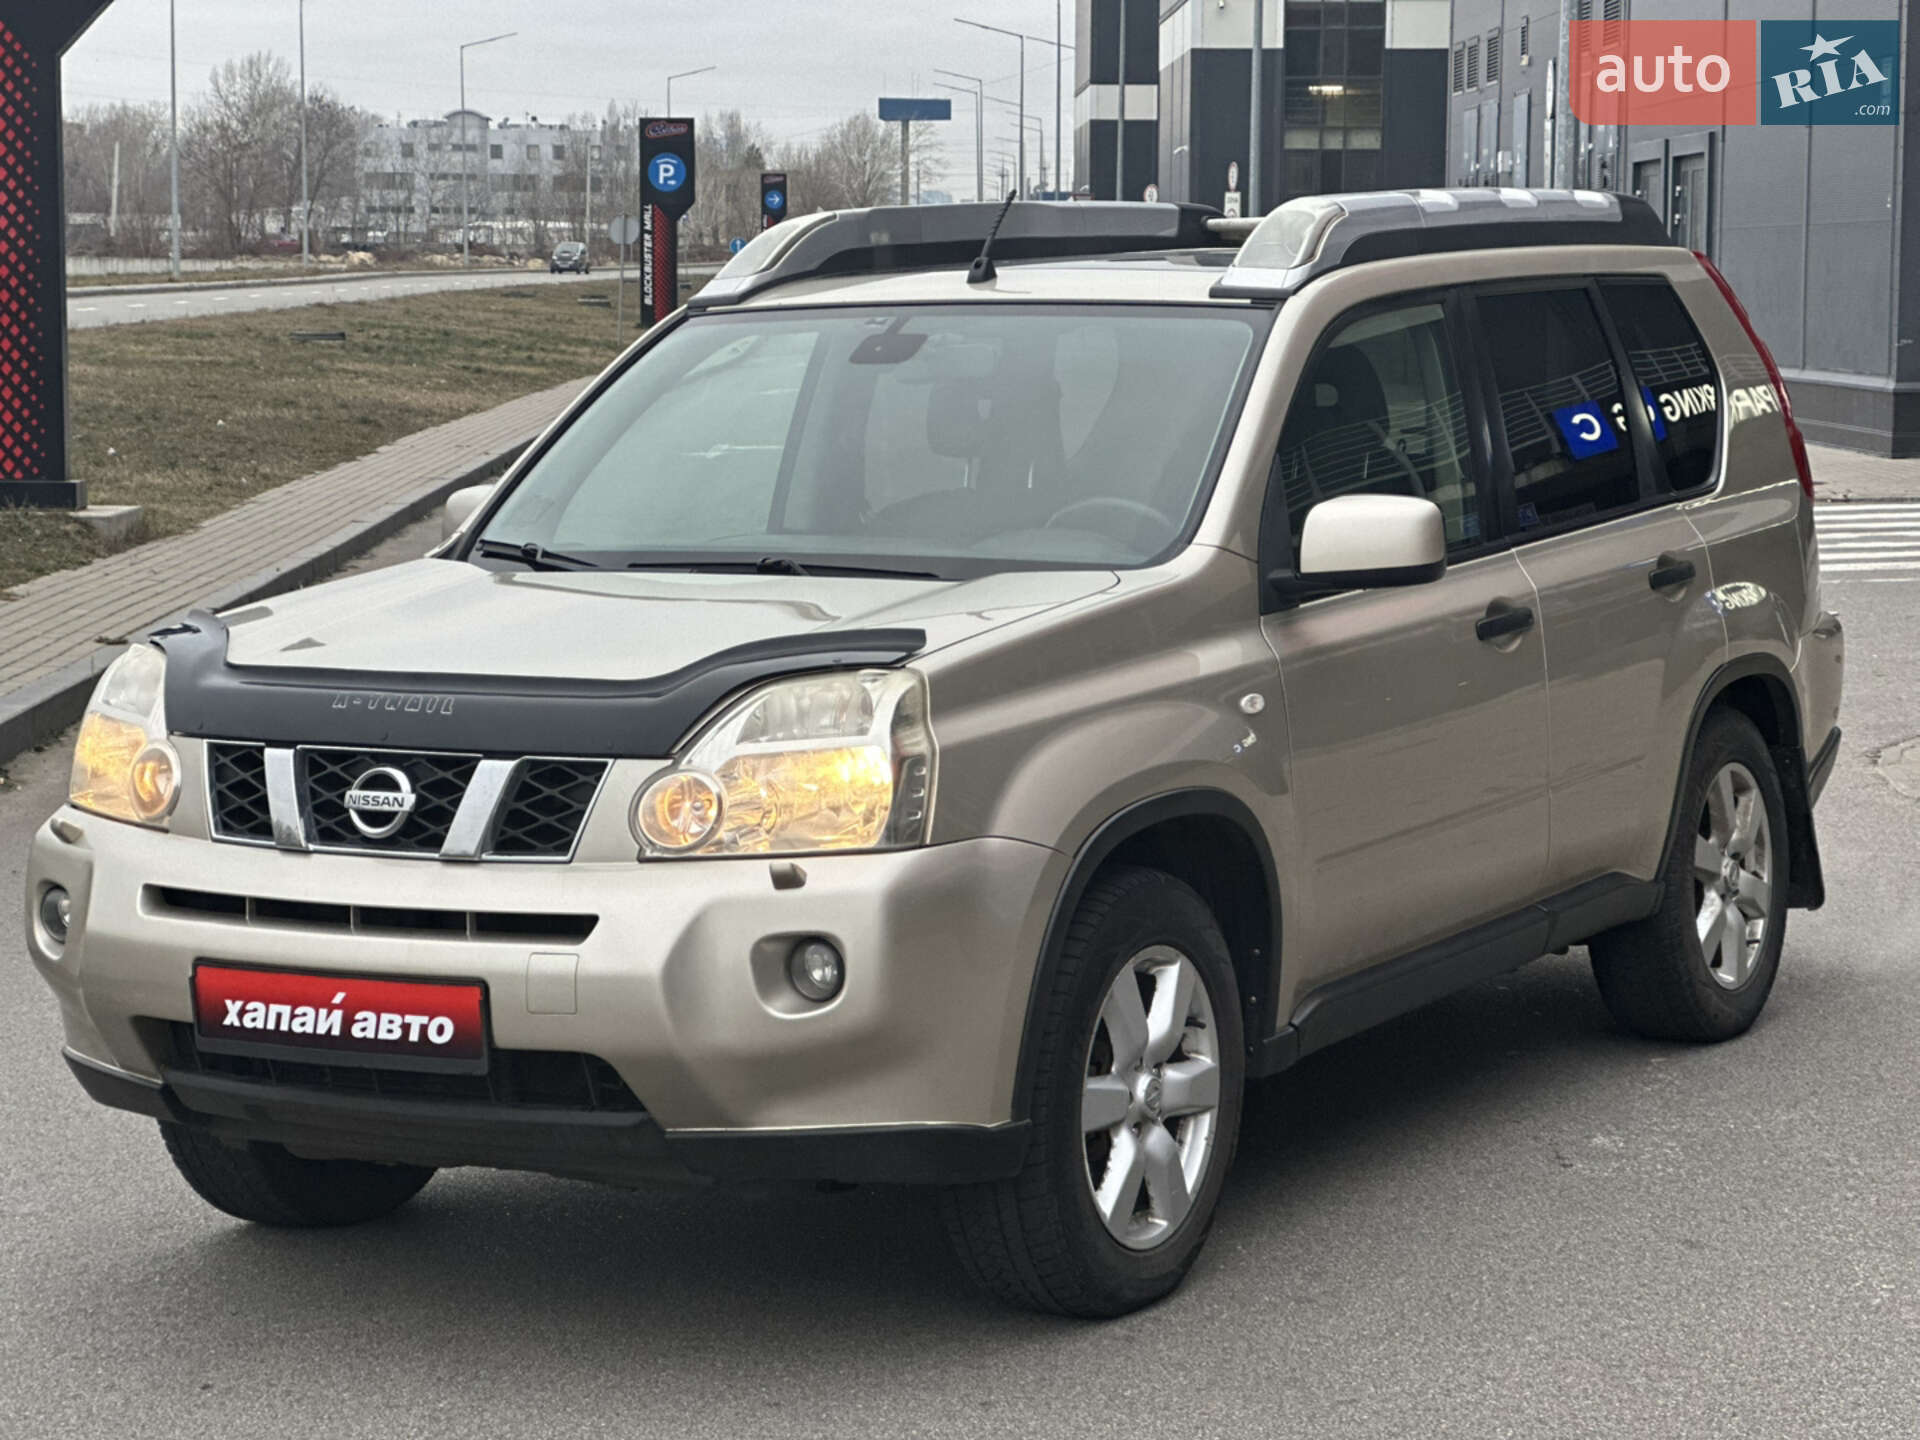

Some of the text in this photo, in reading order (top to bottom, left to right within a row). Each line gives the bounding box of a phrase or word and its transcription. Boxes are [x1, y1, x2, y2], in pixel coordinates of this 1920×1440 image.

[658, 163, 675, 184] P
[643, 203, 653, 306] BLOCKBUSTER MALL
[348, 794, 405, 809] NISSAN
[350, 1010, 455, 1044] авто
